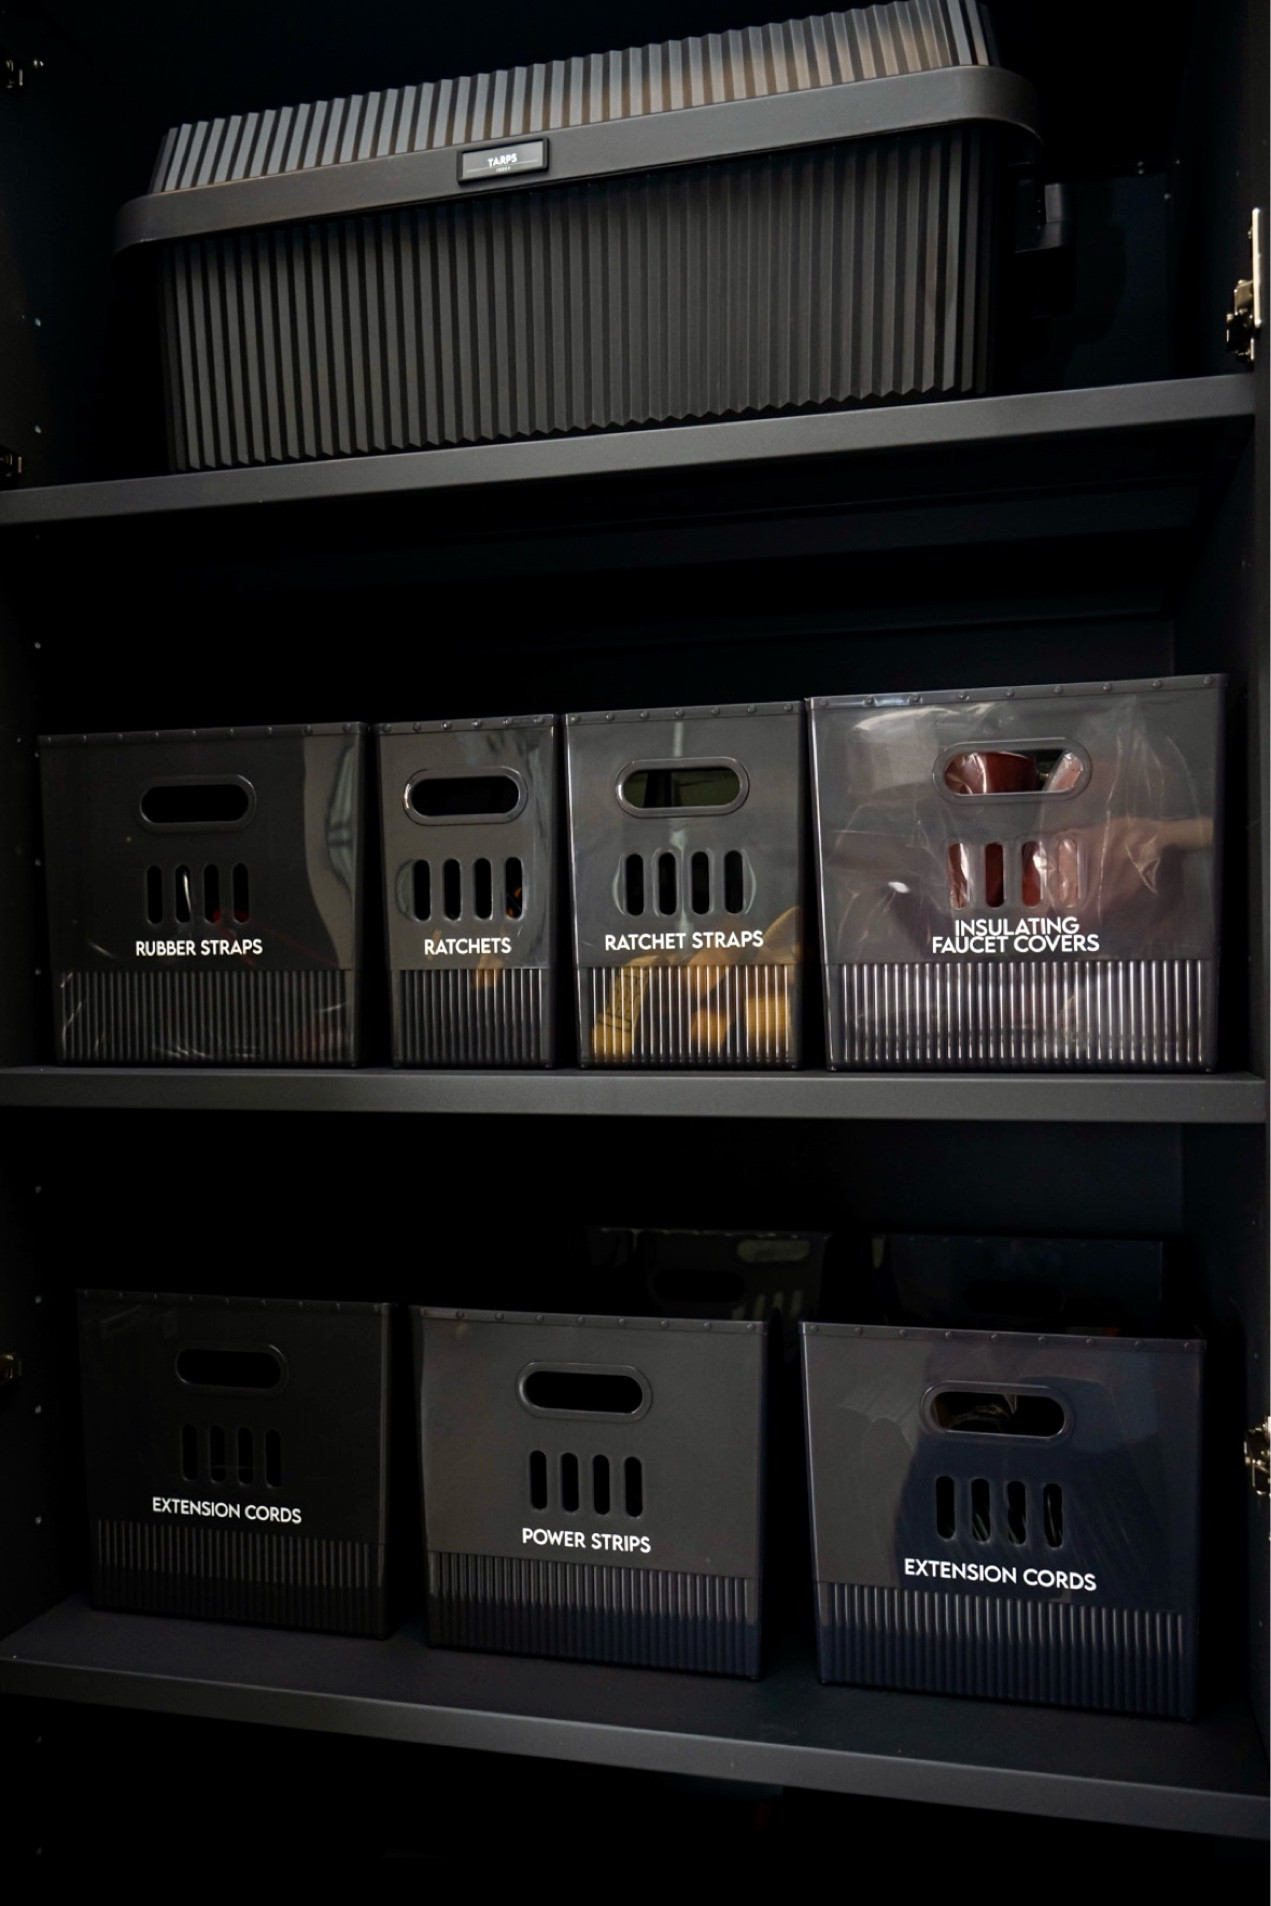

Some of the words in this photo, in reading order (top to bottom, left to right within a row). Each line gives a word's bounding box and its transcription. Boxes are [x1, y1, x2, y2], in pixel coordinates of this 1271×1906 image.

[487, 153, 518, 167] TARPS
[955, 916, 1080, 937] INSULATING
[135, 940, 197, 957] RUBBER
[200, 938, 263, 956] STRAPS
[424, 937, 512, 955] RATCHETS
[604, 932, 688, 951] RATCHET
[691, 930, 764, 949] STRAPS
[932, 934, 1010, 954] FAUCET
[1013, 933, 1100, 953] COVERS
[152, 1497, 241, 1518] EXTENSION
[244, 1504, 302, 1524] CORDS
[522, 1527, 587, 1549] POWER
[591, 1532, 652, 1554] STRIPS
[904, 1557, 1017, 1584] EXTENSION
[1022, 1568, 1097, 1591] CORDS
